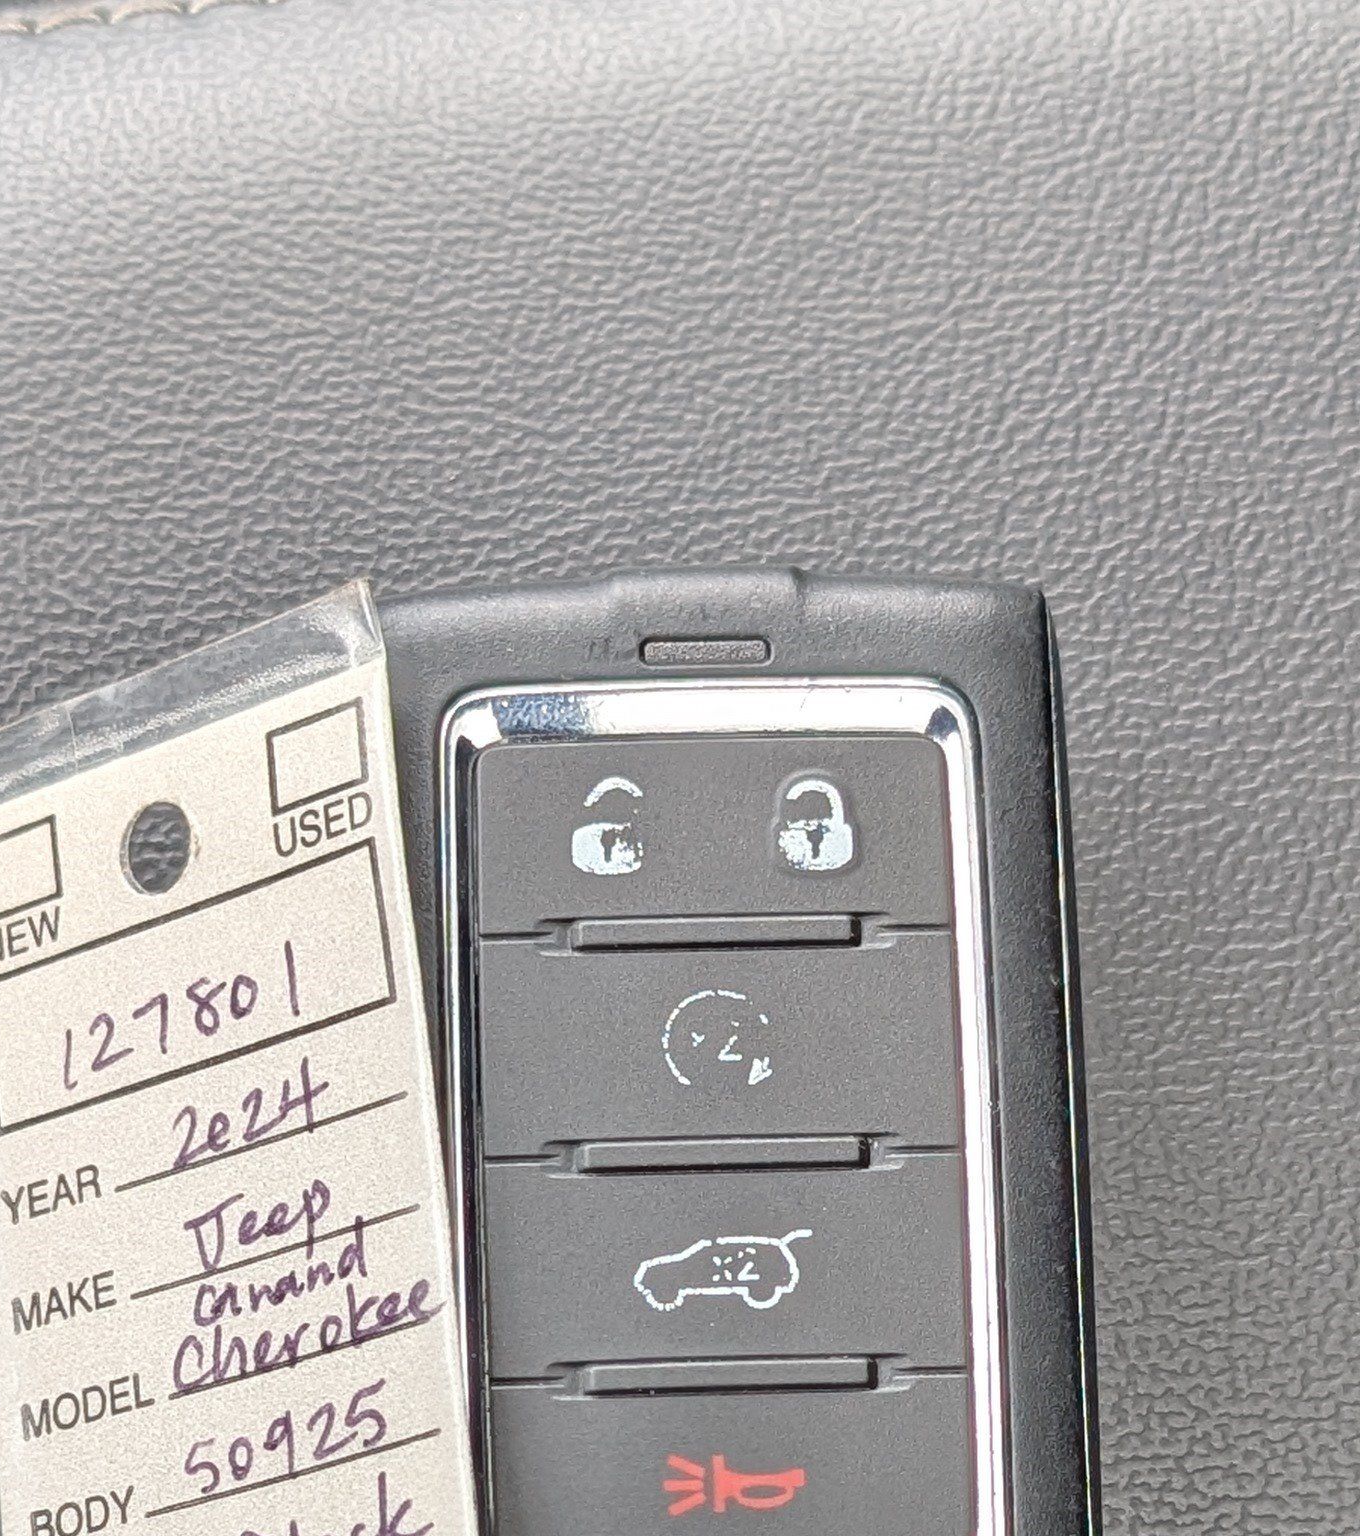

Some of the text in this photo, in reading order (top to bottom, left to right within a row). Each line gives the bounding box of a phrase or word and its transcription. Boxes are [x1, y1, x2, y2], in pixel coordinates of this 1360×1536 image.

[272, 791, 374, 857] USED
[63, 940, 301, 1091] 127801
[0, 1164, 102, 1225] YEAR
[184, 1179, 331, 1271] Jeep
[11, 1270, 118, 1335] MAKE
[173, 1280, 447, 1390] Cherokee
[20, 1373, 155, 1441] MODEL
[184, 1379, 388, 1493] 50925
